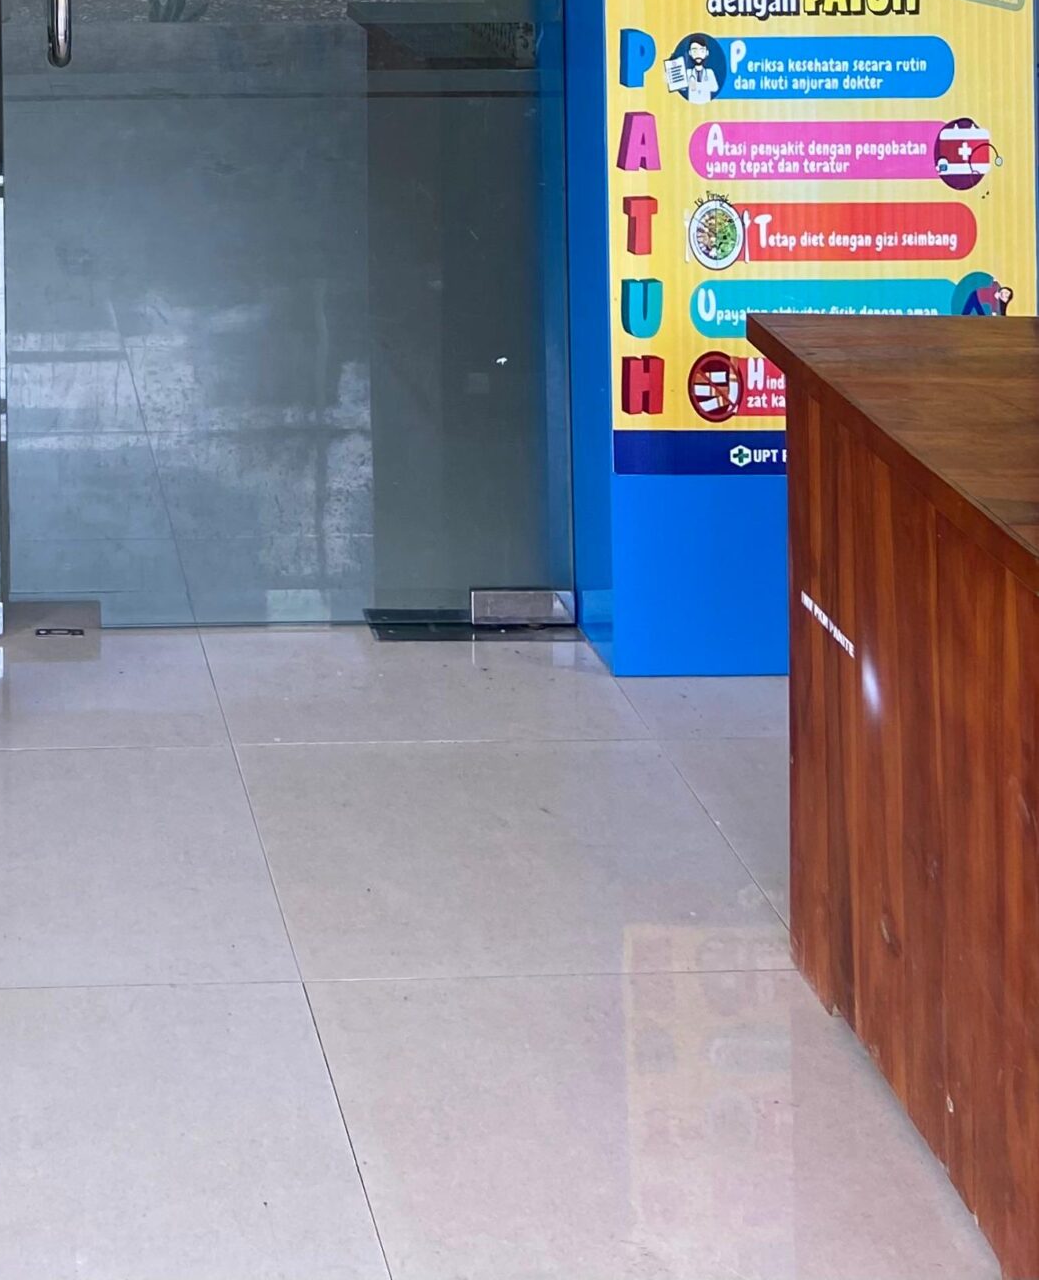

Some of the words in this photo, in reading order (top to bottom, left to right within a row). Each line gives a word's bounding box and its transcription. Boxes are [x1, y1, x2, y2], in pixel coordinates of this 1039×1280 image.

[788, 58, 849, 72] kesehatan
[853, 58, 892, 72] secara
[896, 58, 927, 72] rutin
[734, 75, 756, 90] dan
[760, 75, 788, 90] ikuti
[792, 75, 839, 94] anjuran
[843, 75, 883, 90] dokter
[750, 140, 805, 160] penyakit
[808, 140, 851, 159] dengan
[855, 140, 927, 160] pengobatan
[706, 159, 736, 177] yang
[740, 159, 774, 177] tepat
[777, 158, 799, 173] dan
[803, 158, 849, 173] teratur
[753, 214, 796, 251] Tetap
[800, 231, 825, 247] diet
[828, 231, 872, 252] dengan
[875, 232, 899, 251] gizi
[901, 231, 957, 251] seimbang
[747, 395, 767, 408] zat
[753, 449, 778, 463] UPT
[829, 619, 855, 658] PANITE
